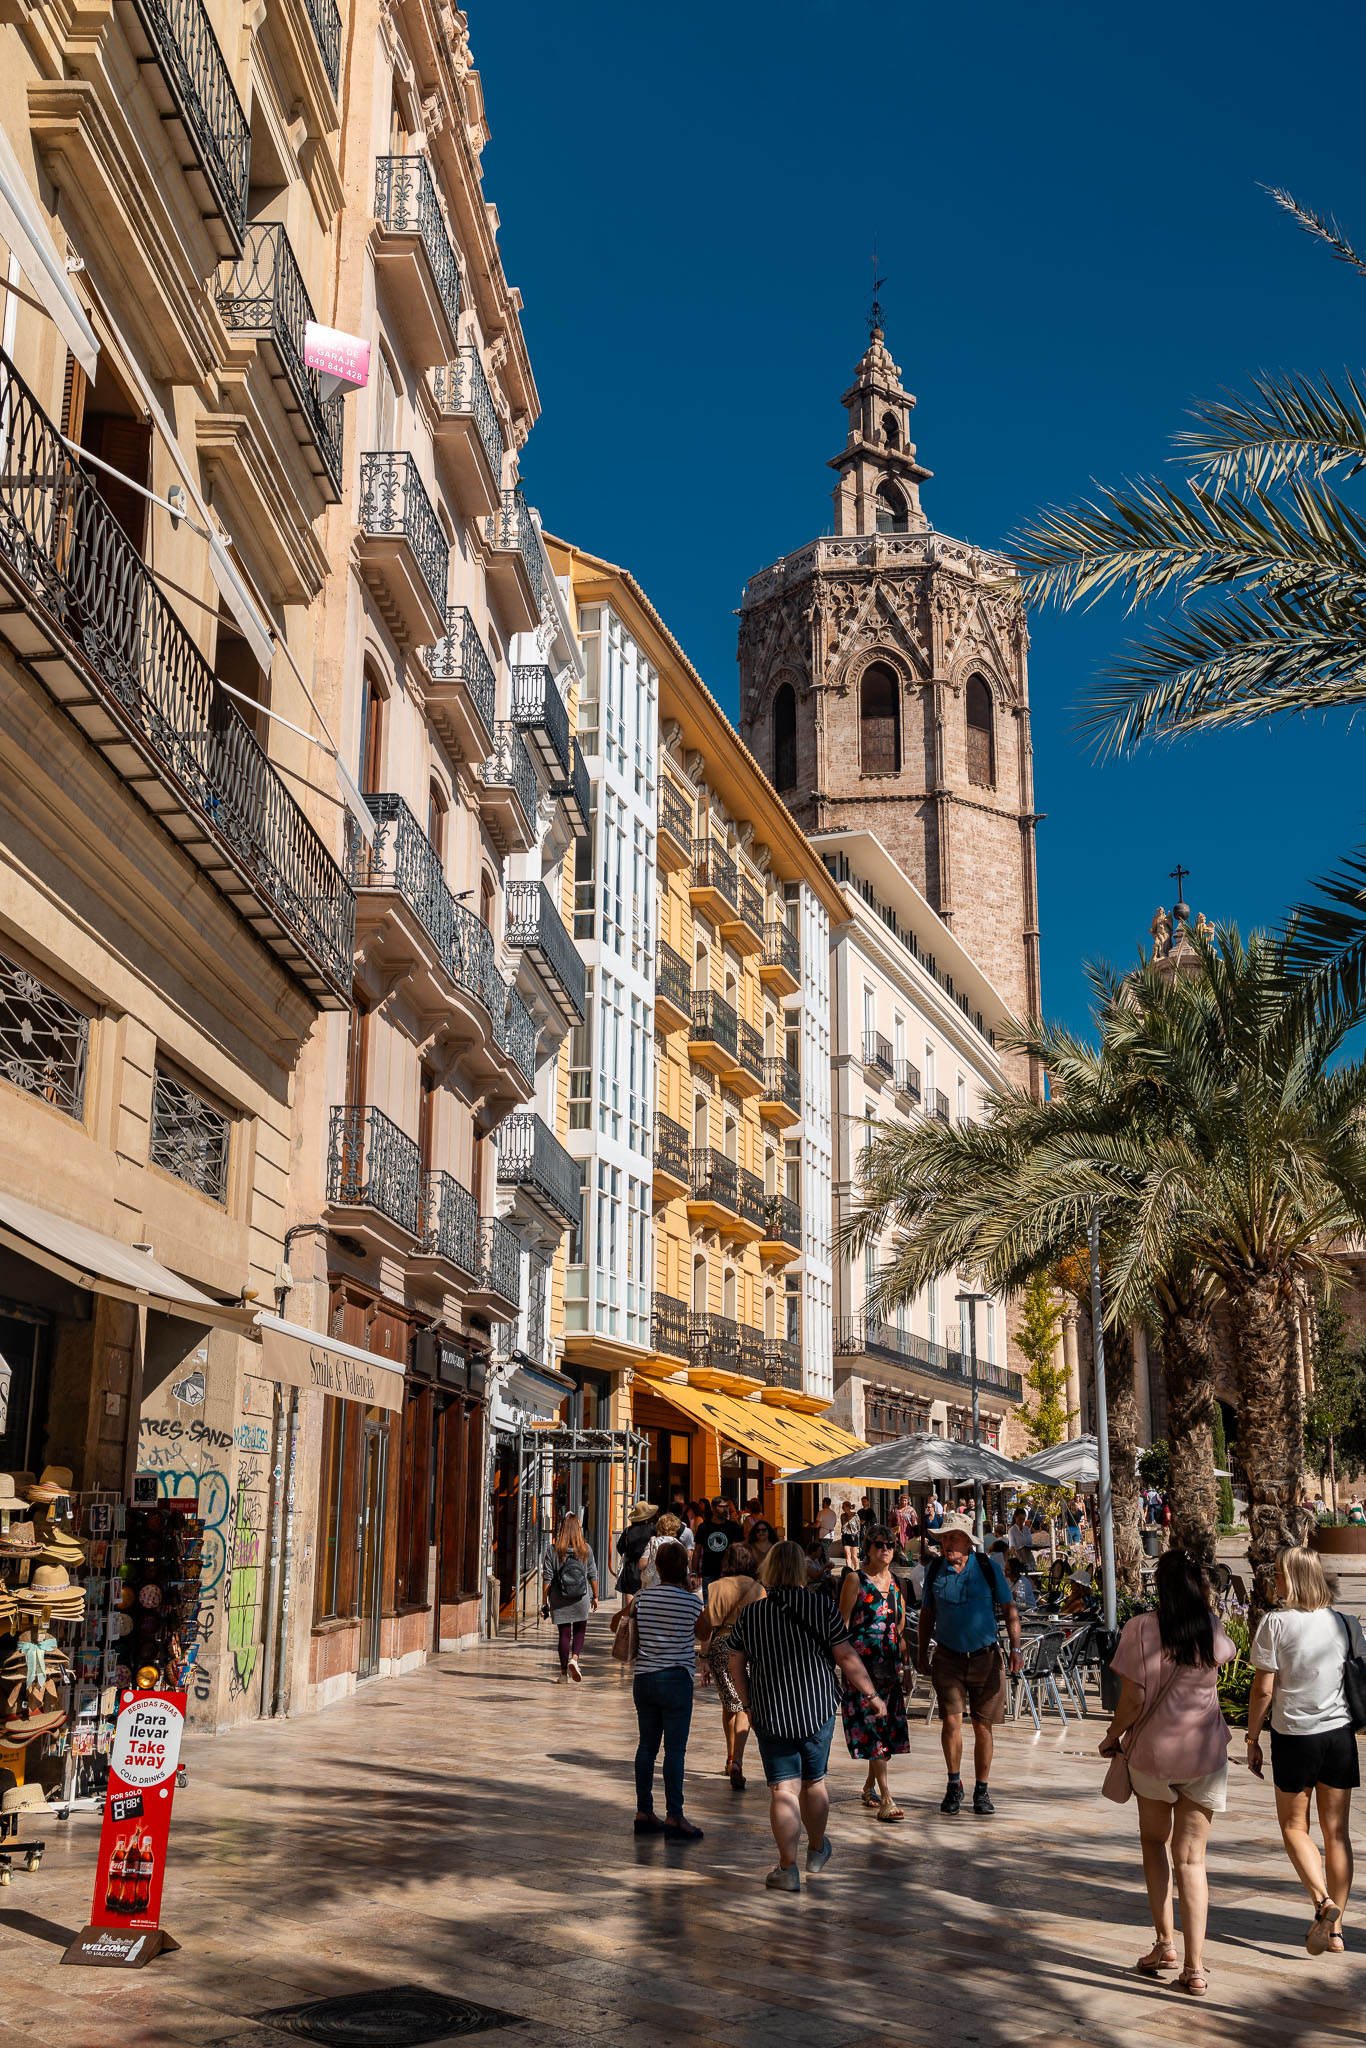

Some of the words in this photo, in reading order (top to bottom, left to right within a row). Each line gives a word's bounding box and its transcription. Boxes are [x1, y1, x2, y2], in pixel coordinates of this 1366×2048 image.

[317, 347, 356, 368] GARAJE
[327, 362, 343, 374] 844
[346, 369, 363, 381] 428
[309, 1347, 333, 1389] Smile
[335, 1359, 342, 1392] &
[343, 1360, 375, 1399] Valencia
[127, 1700, 158, 1715] BEBIDAS
[135, 1712, 166, 1726] Para
[129, 1725, 169, 1739] llevar
[129, 1740, 165, 1754] Take
[124, 1754, 166, 1770] away
[120, 1768, 138, 1783] COLD
[138, 1771, 166, 1784] DRINKS
[110, 1792, 124, 1801] POR
[124, 1788, 143, 1797] SOLO
[81, 1943, 131, 1953] WELCOME
